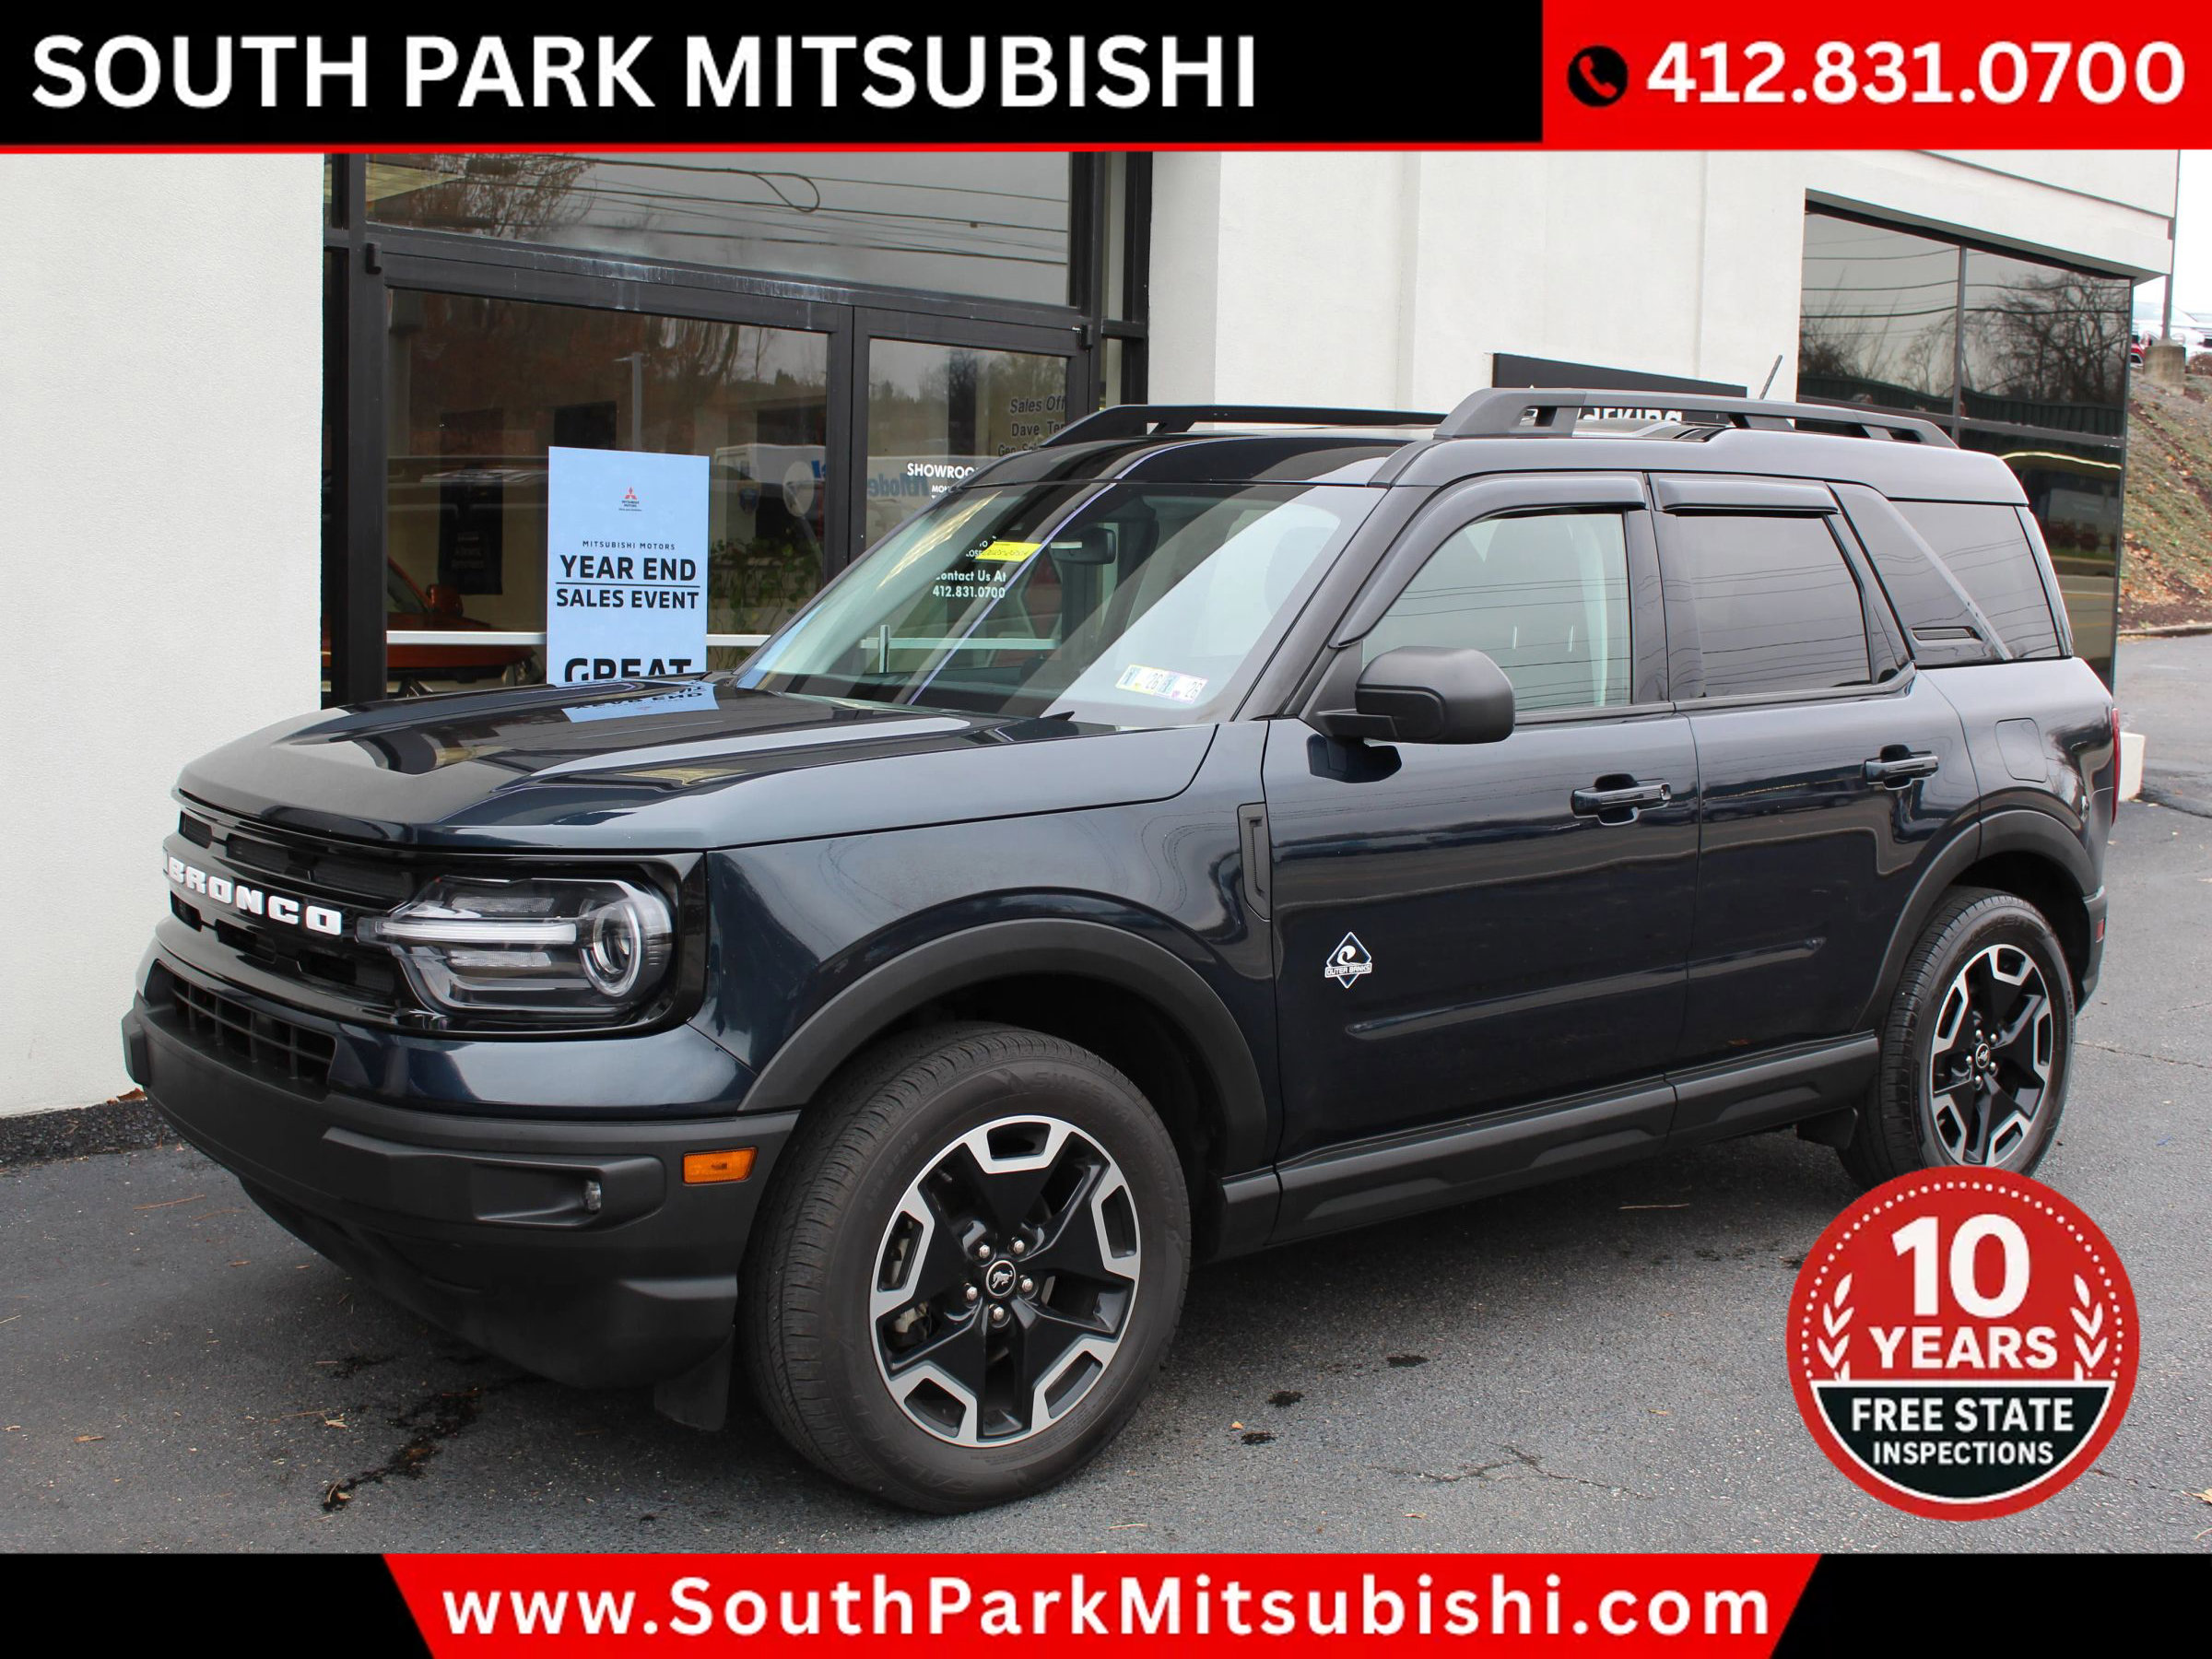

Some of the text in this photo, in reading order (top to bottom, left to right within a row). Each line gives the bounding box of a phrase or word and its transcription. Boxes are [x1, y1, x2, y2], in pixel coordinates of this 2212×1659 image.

[1010, 397, 1042, 414] Sales
[1011, 422, 1040, 437] Dave
[907, 463, 979, 479] SHOWROO
[582, 540, 636, 549] MITSUBISHI
[559, 555, 697, 581] YEAR END
[977, 570, 991, 582] Us
[994, 570, 1006, 582] At
[556, 588, 700, 609] SALES EVENT
[932, 585, 1006, 598] 412.831.0700
[167, 856, 343, 935] BRONCO
[1327, 967, 1347, 975] OUTER
